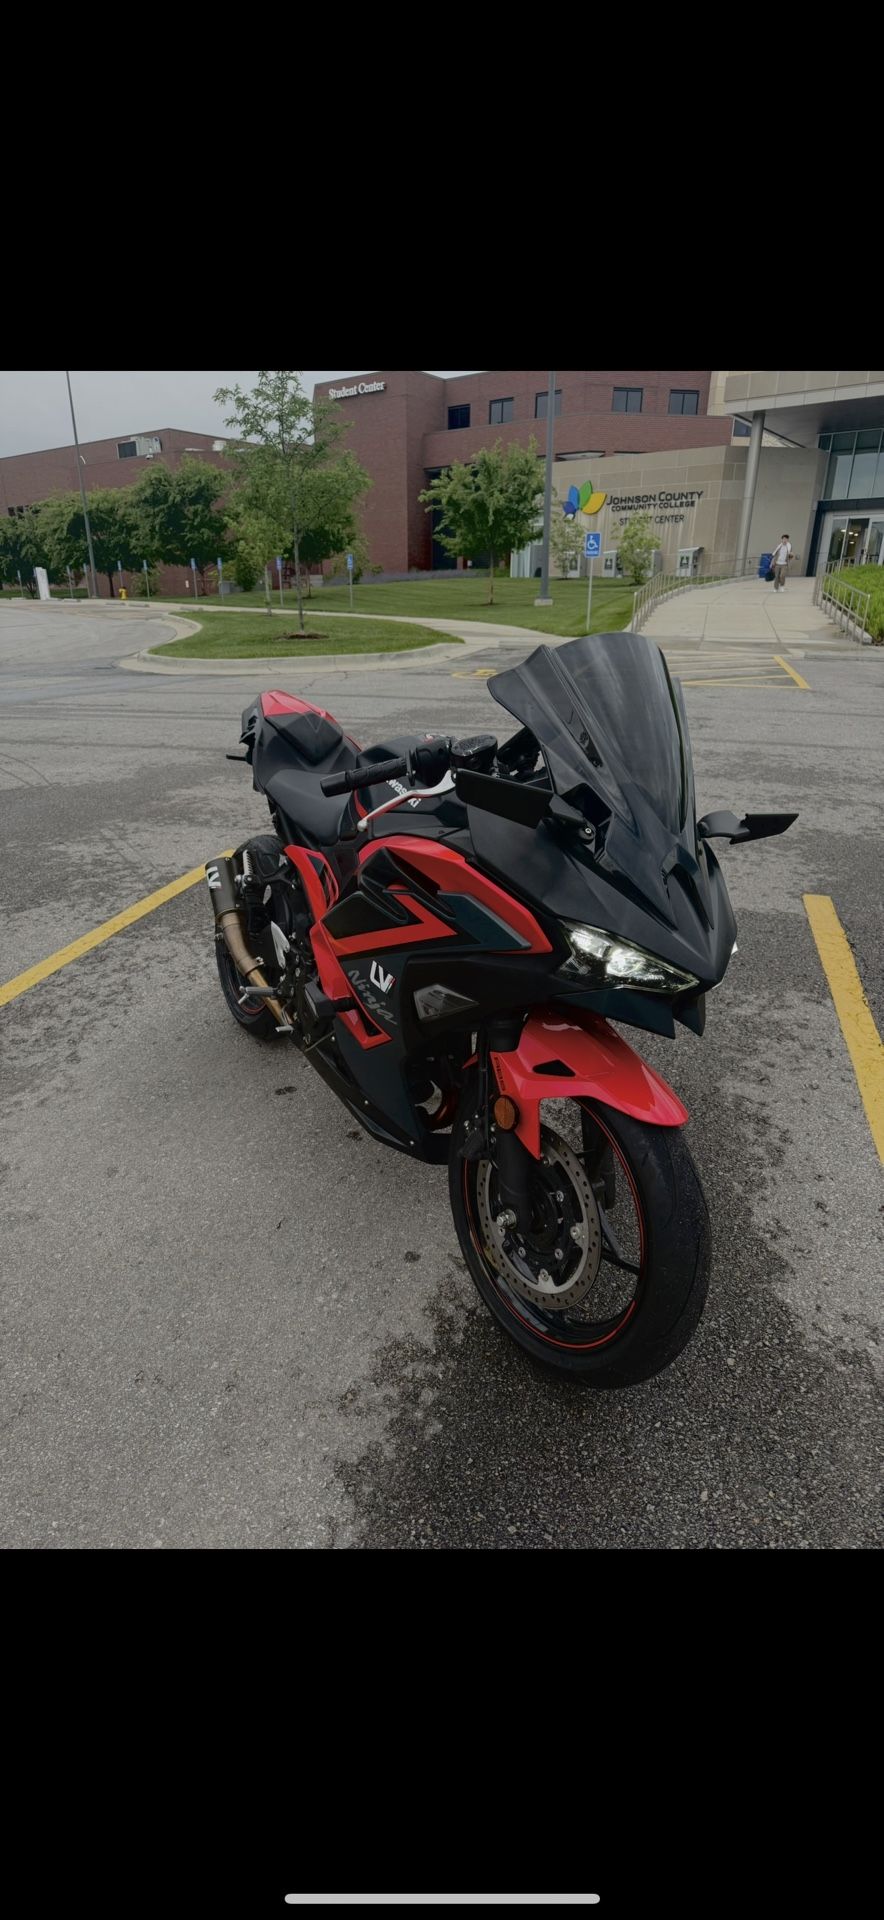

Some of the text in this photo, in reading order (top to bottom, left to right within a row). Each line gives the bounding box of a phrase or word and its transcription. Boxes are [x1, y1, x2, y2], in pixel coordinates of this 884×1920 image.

[329, 382, 384, 400] Student Center
[606, 491, 704, 505] JOHNSON COUNTY
[611, 500, 695, 512] COMMUNITY COLLEGE
[655, 514, 684, 524] CENTER
[386, 779, 421, 808] waski
[348, 970, 398, 1025] Ninja
